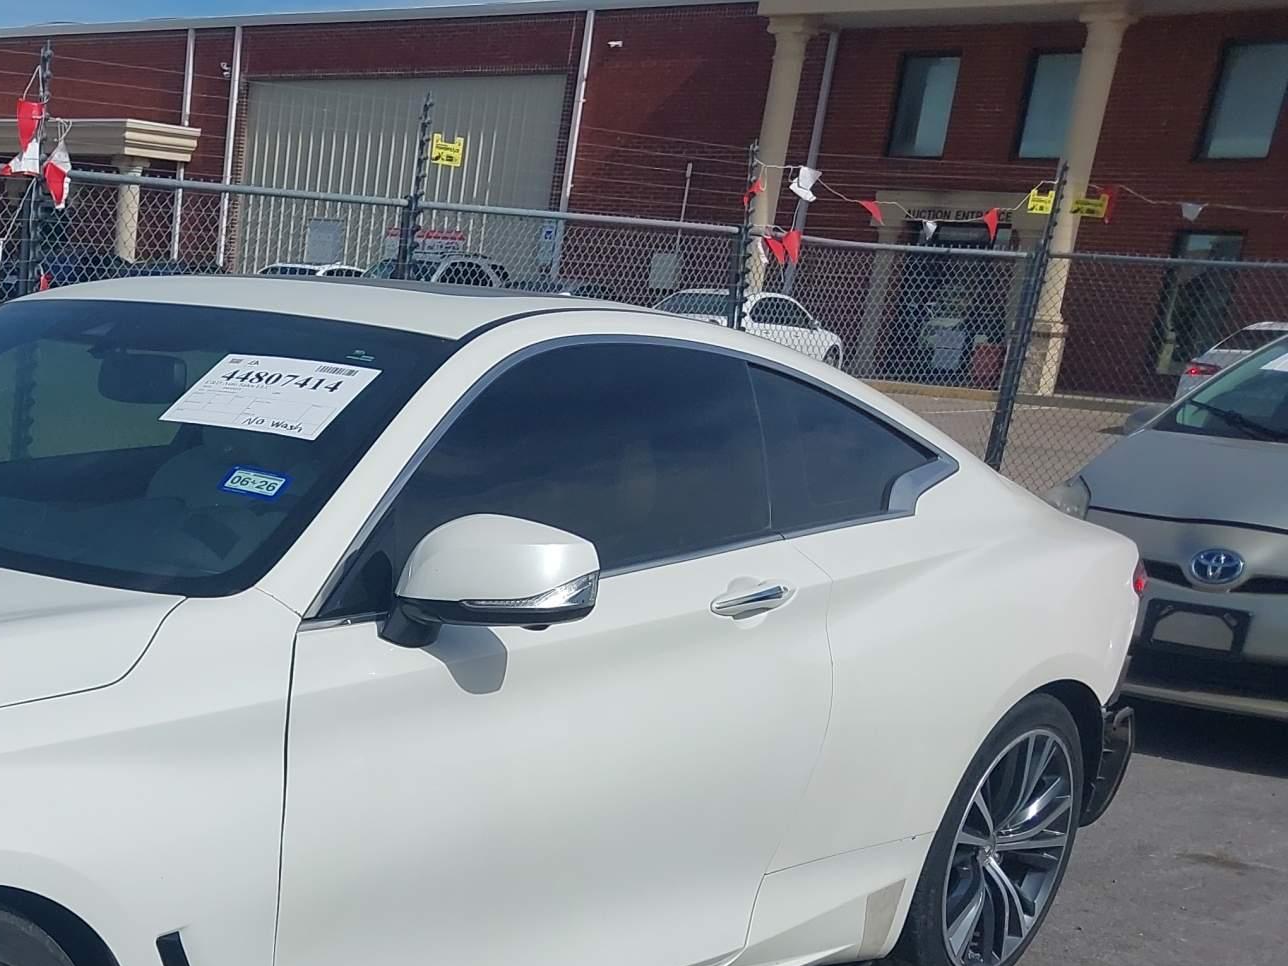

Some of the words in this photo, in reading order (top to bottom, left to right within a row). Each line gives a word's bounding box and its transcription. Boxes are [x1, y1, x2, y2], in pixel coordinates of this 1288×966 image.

[905, 208, 951, 221] AUCTION
[955, 210, 1013, 223] ENTRCE
[221, 369, 343, 393] 44807414
[270, 419, 303, 434] Wash
